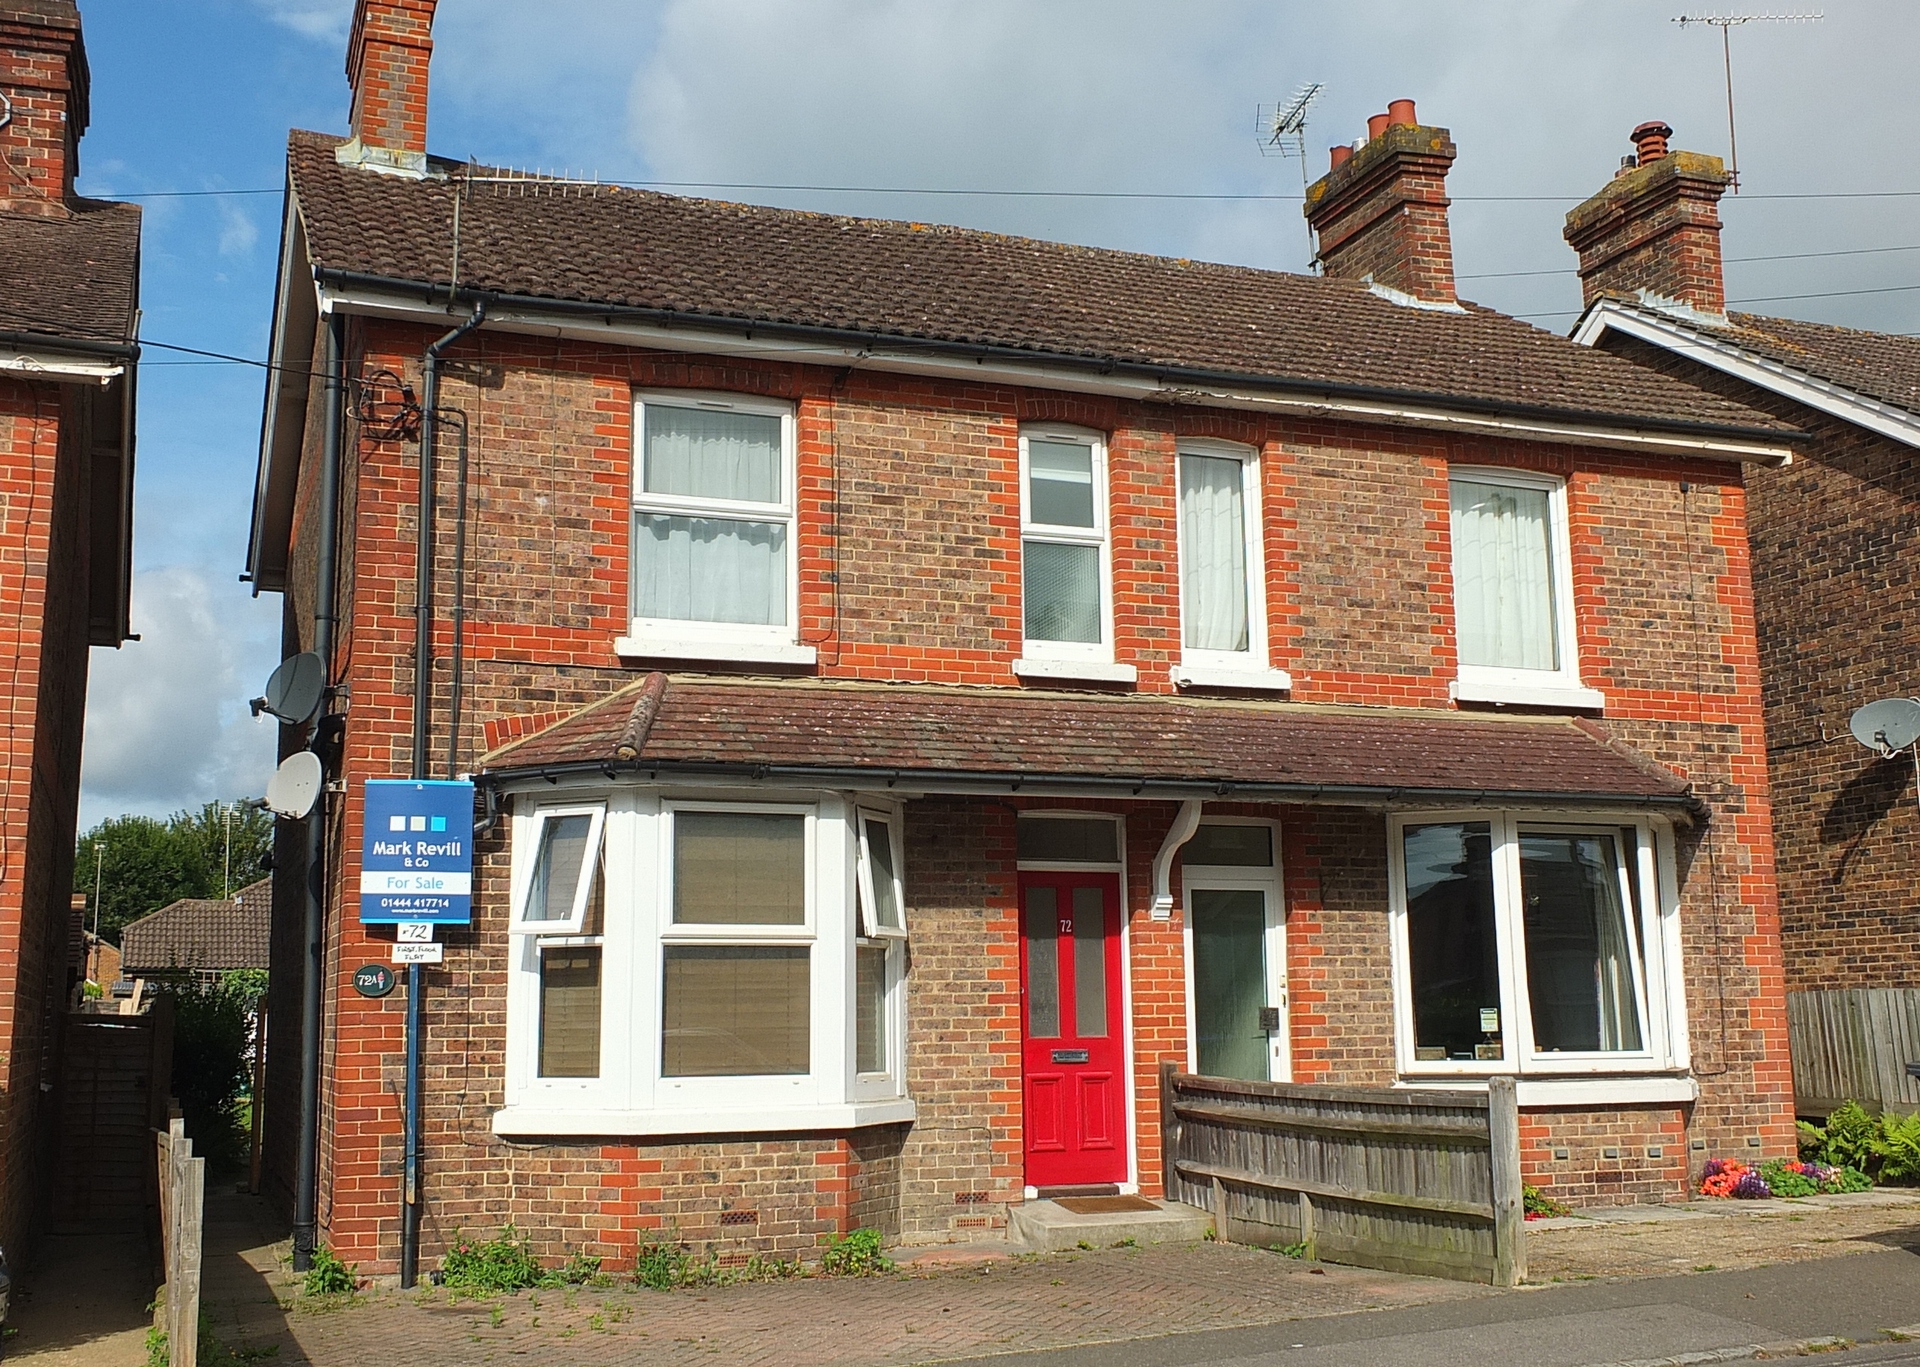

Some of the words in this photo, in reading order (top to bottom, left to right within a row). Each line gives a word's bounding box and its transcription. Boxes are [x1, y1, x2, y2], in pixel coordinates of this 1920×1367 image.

[372, 841, 412, 855] Mark
[416, 841, 461, 856] Revill
[404, 858, 413, 867] &
[415, 858, 429, 867] Co
[387, 876, 410, 889] For
[415, 877, 444, 889] Sale
[381, 898, 412, 907] 01444
[413, 898, 449, 908] 417714
[1060, 919, 1072, 933] 72
